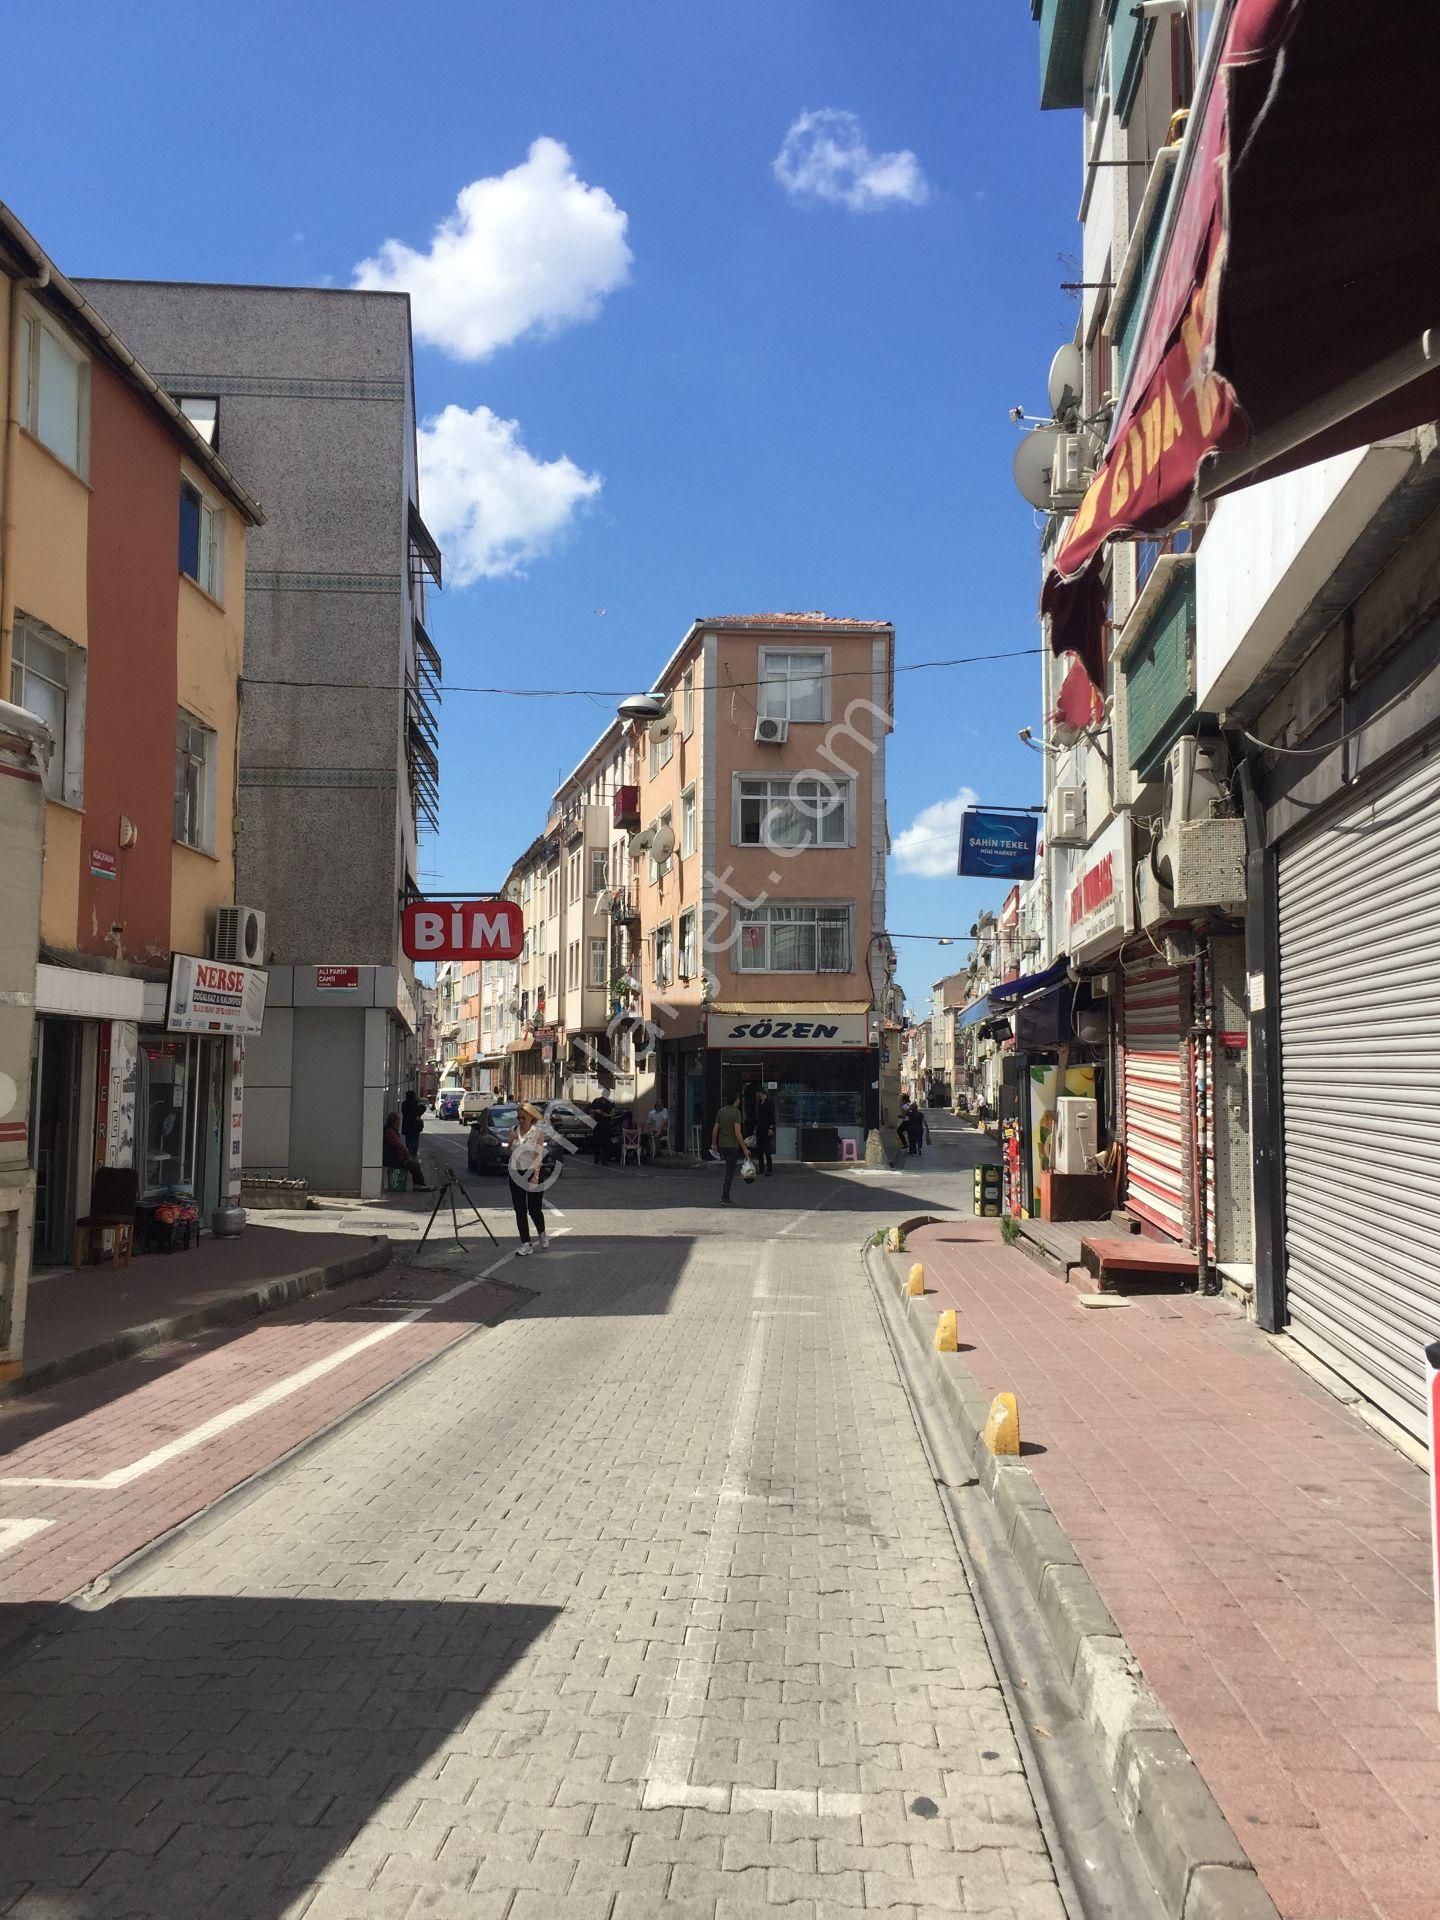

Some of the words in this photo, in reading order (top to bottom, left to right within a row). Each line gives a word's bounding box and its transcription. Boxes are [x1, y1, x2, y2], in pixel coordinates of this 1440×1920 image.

[969, 836, 998, 847] ŞAHİN
[999, 840, 1029, 850] TEKEL
[415, 903, 511, 950] BİM
[196, 964, 244, 992] NERSE
[728, 1018, 839, 1038] SÖZEN
